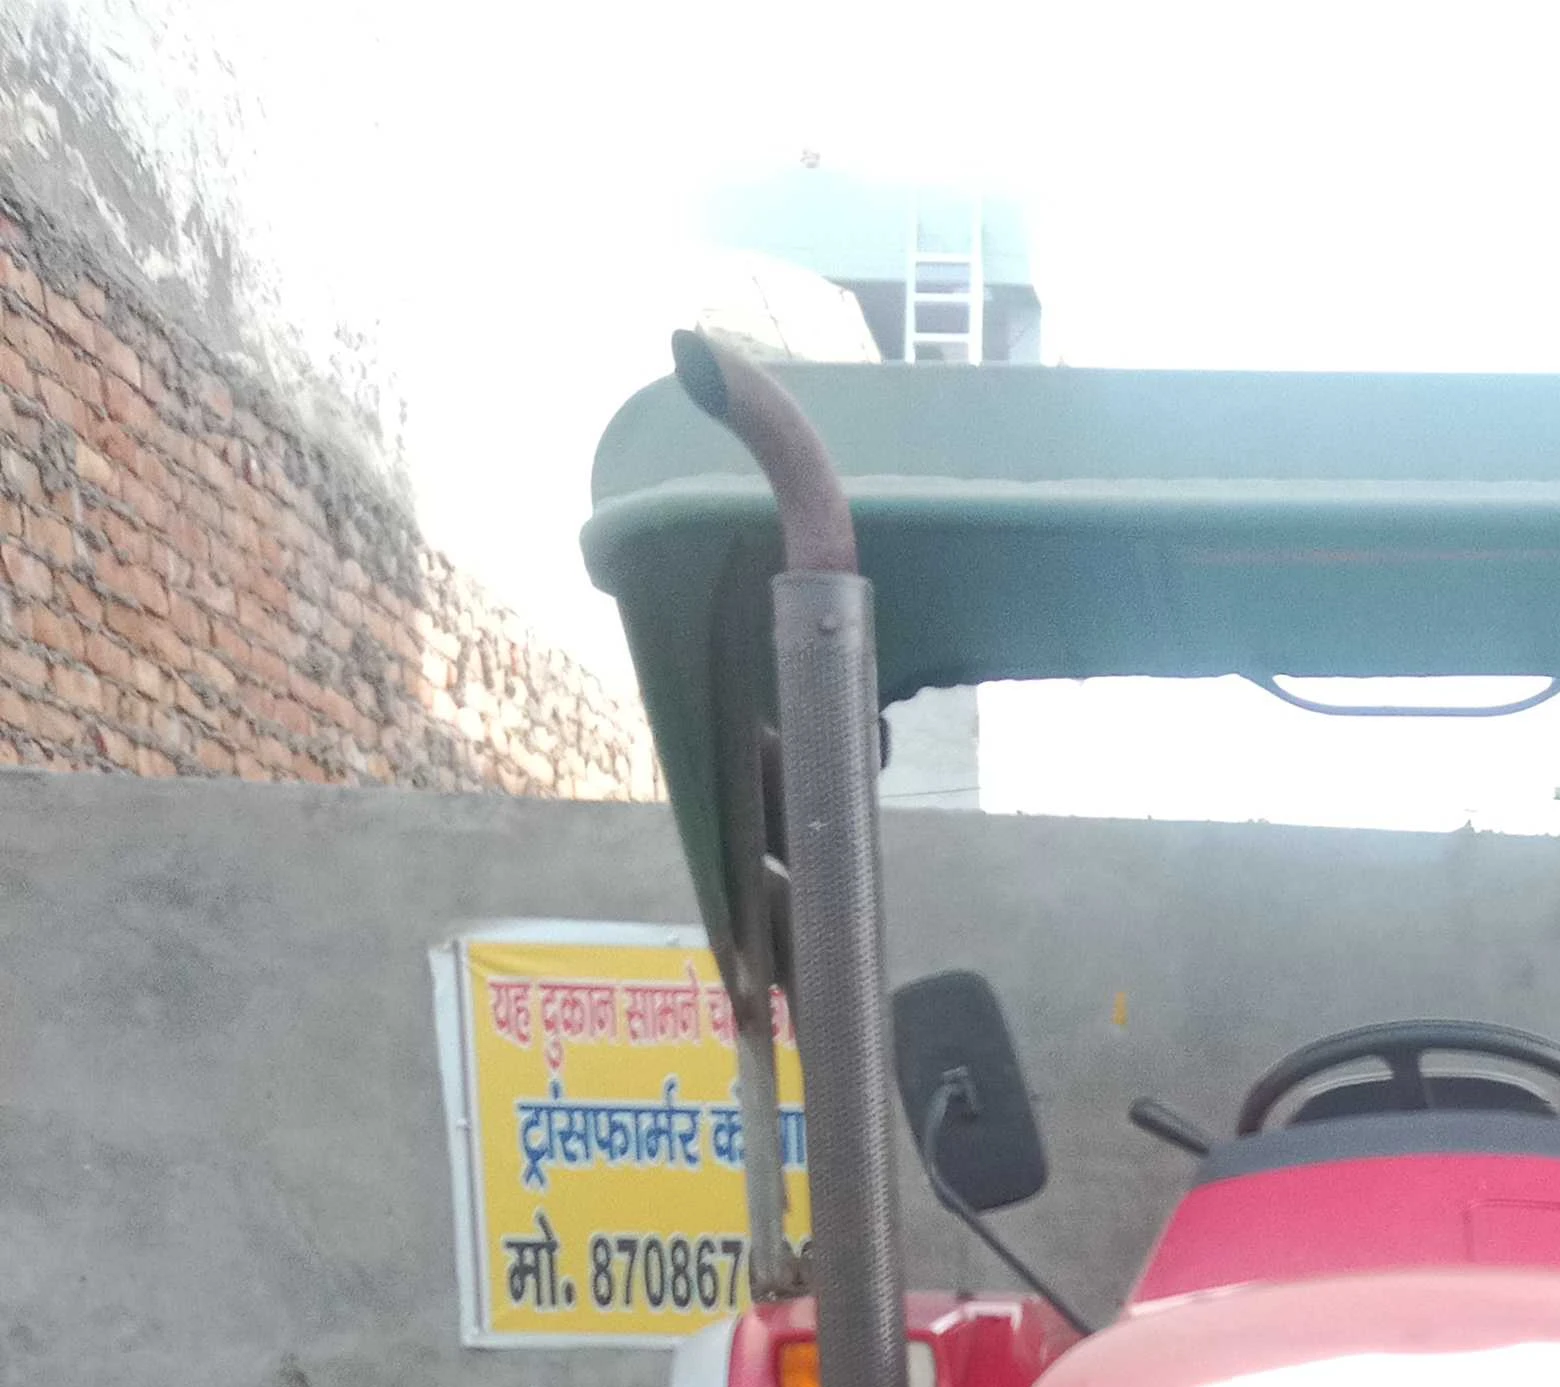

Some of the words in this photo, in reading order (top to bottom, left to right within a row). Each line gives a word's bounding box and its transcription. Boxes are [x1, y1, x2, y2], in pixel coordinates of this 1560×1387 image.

[489, 981, 532, 1044] यह
[539, 983, 617, 1071] दुकान
[623, 957, 701, 1043] सामने
[518, 1078, 702, 1187] ट्रांसफार्मर
[504, 1211, 577, 1308] मो.
[590, 1236, 750, 1308] 870867
